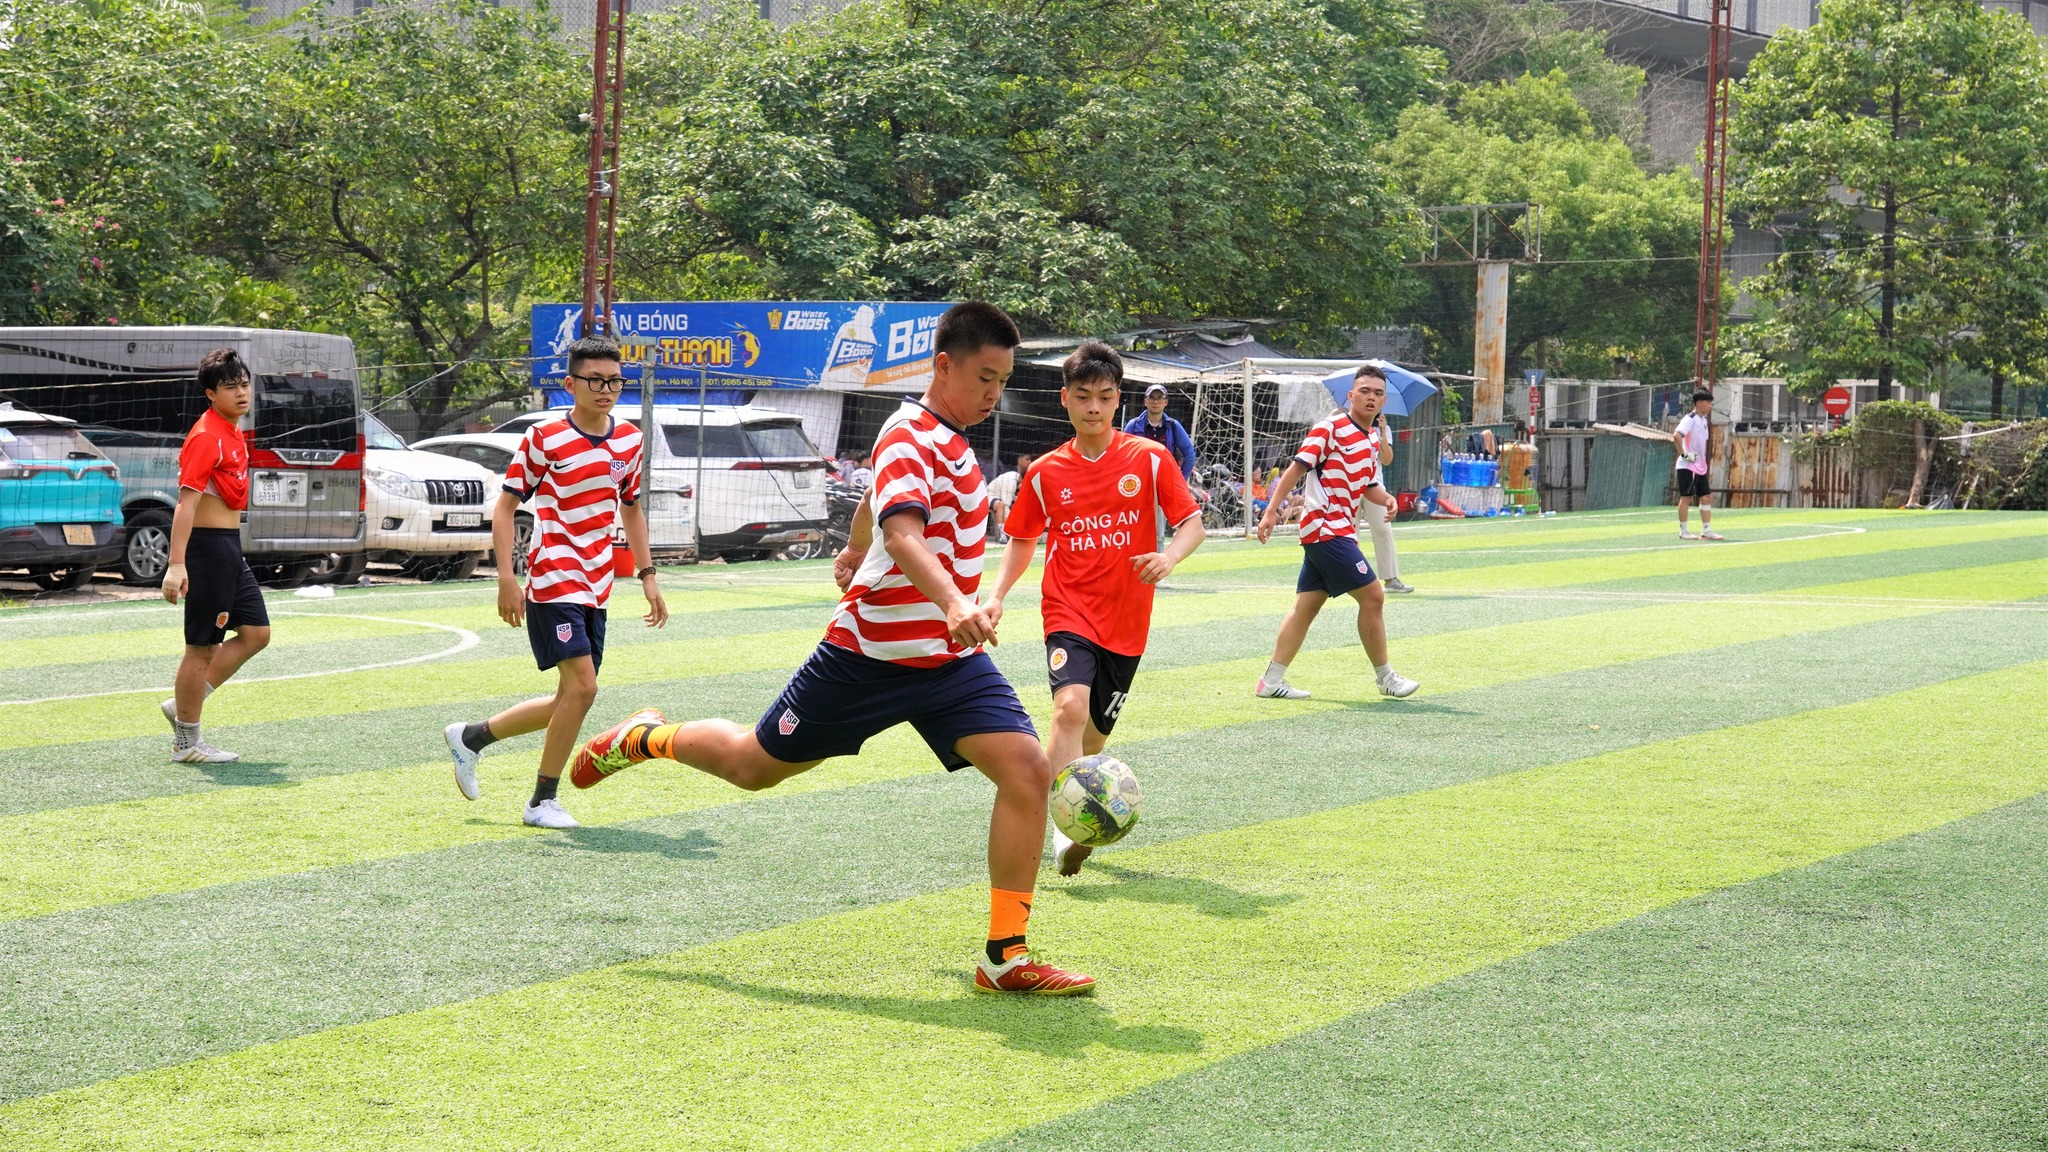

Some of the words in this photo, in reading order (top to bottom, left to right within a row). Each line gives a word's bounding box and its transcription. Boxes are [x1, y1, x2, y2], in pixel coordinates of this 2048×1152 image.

[638, 310, 688, 330] BÓNG
[783, 310, 831, 331] Boost
[801, 310, 828, 318] Water
[140, 343, 174, 354] DCAR
[175, 347, 213, 355] LIMOUSIN
[658, 337, 732, 367] THANH
[838, 341, 874, 359] Boost
[611, 461, 625, 471] USA
[1060, 514, 1112, 535] CÔNG
[1116, 509, 1140, 526] AN
[1070, 533, 1097, 552] HÀ
[1101, 529, 1131, 550] NỘI
[557, 624, 570, 633] USA
